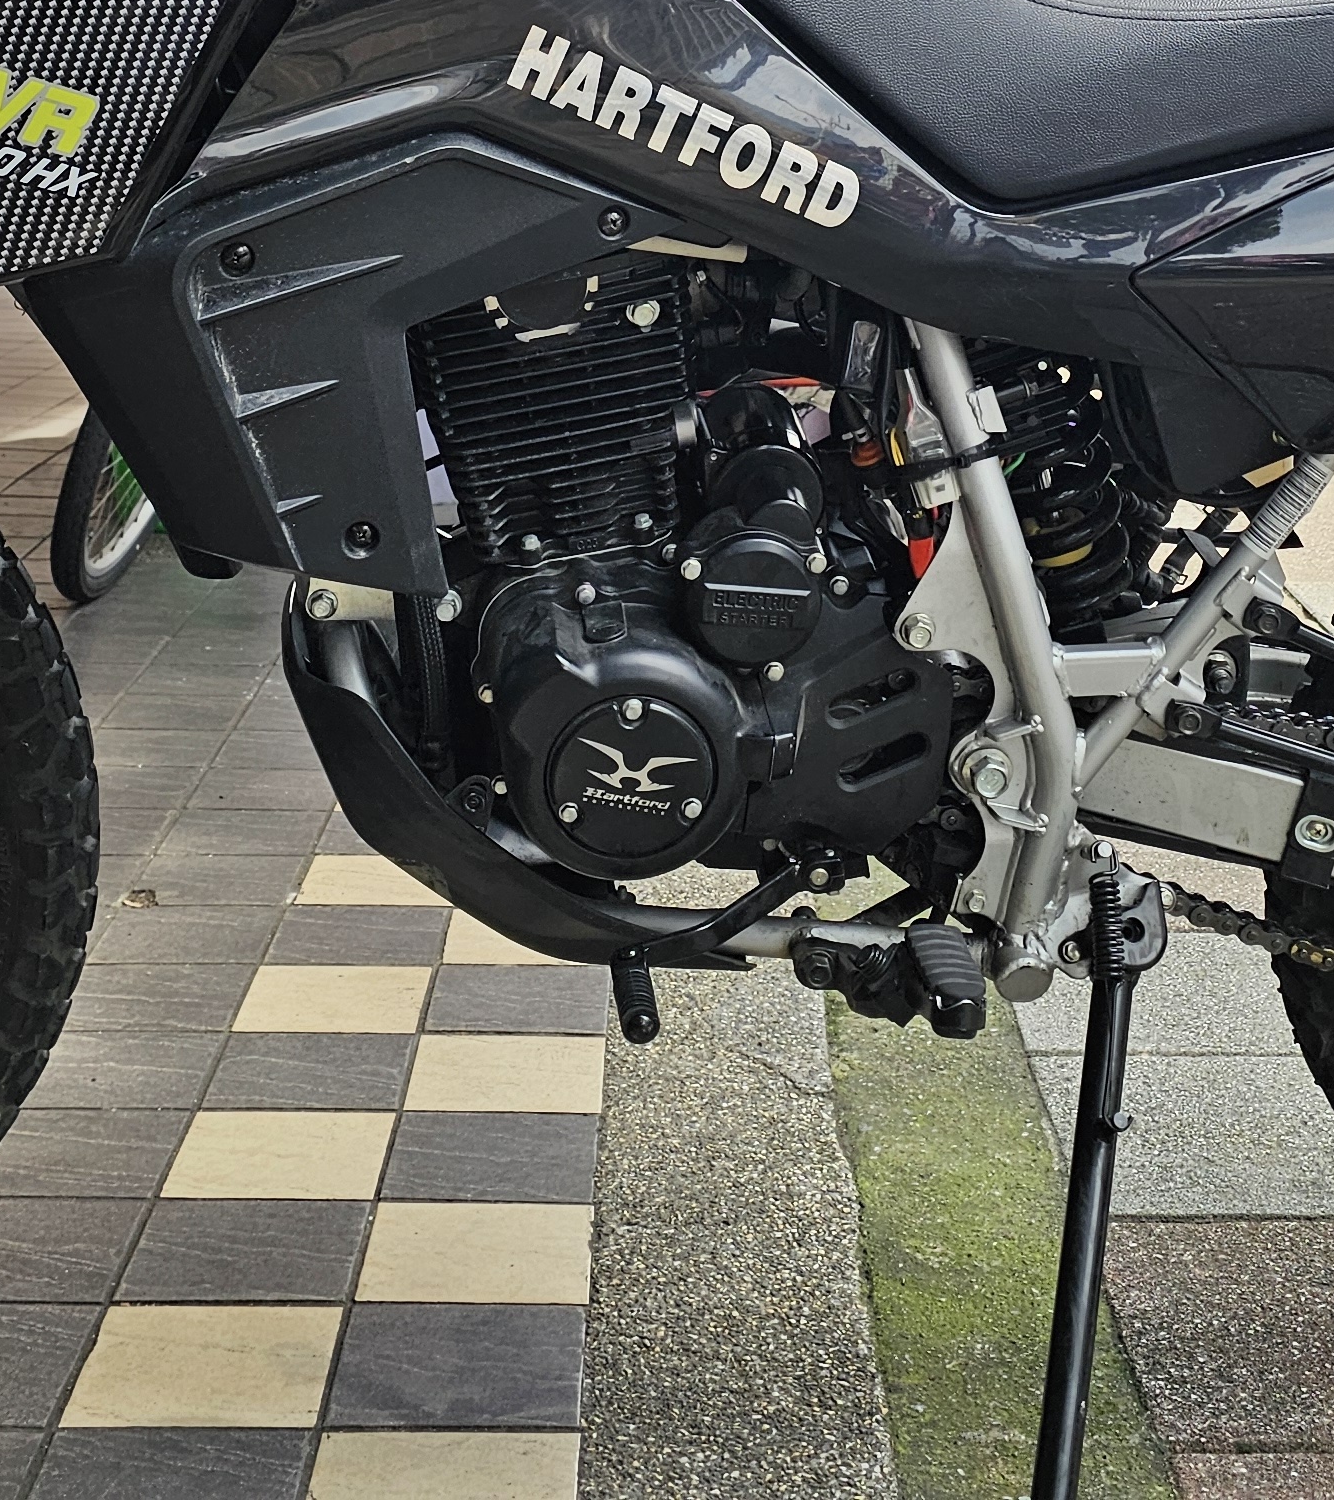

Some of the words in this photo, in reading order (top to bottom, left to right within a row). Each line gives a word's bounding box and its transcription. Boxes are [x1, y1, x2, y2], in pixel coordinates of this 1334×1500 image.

[506, 24, 860, 228] HARTFORD
[20, 158, 99, 198] HX
[712, 591, 799, 613] ELECTRIC
[719, 611, 794, 629] STARTER
[582, 786, 671, 810] Hartford
